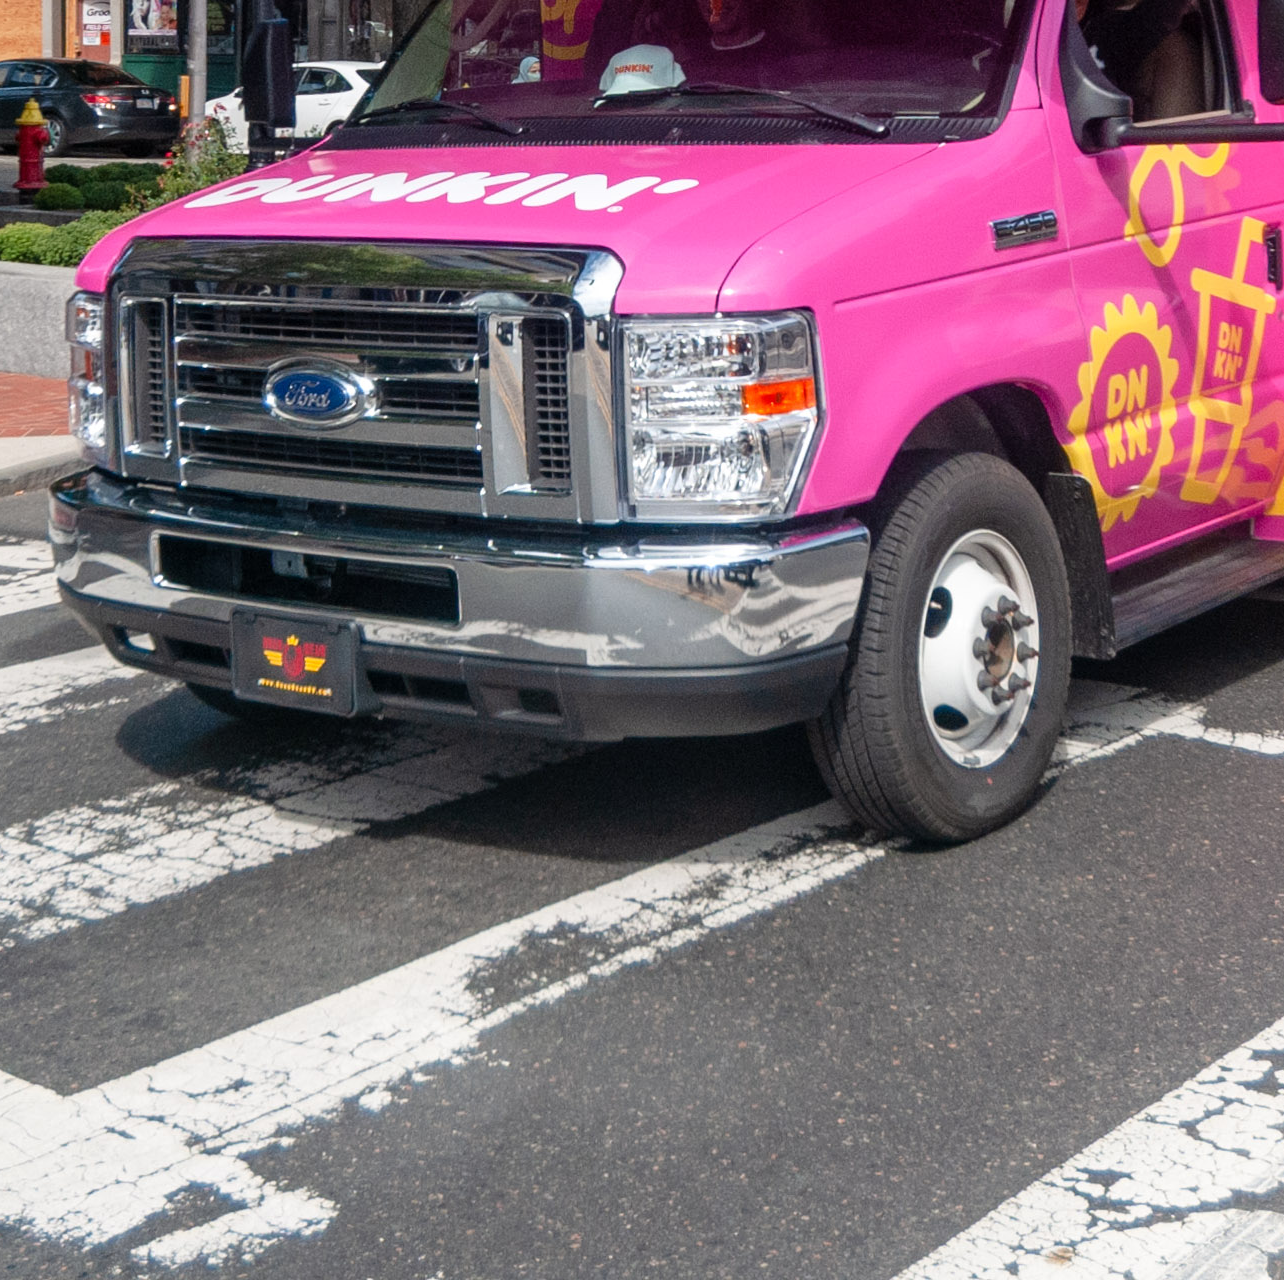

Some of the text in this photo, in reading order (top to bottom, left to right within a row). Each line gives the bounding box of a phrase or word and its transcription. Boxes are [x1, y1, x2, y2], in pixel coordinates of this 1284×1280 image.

[183, 172, 700, 211] DUNKIN'
[1218, 321, 1243, 353] DN
[285, 381, 333, 408] Ford
[1106, 364, 1149, 419] DN
